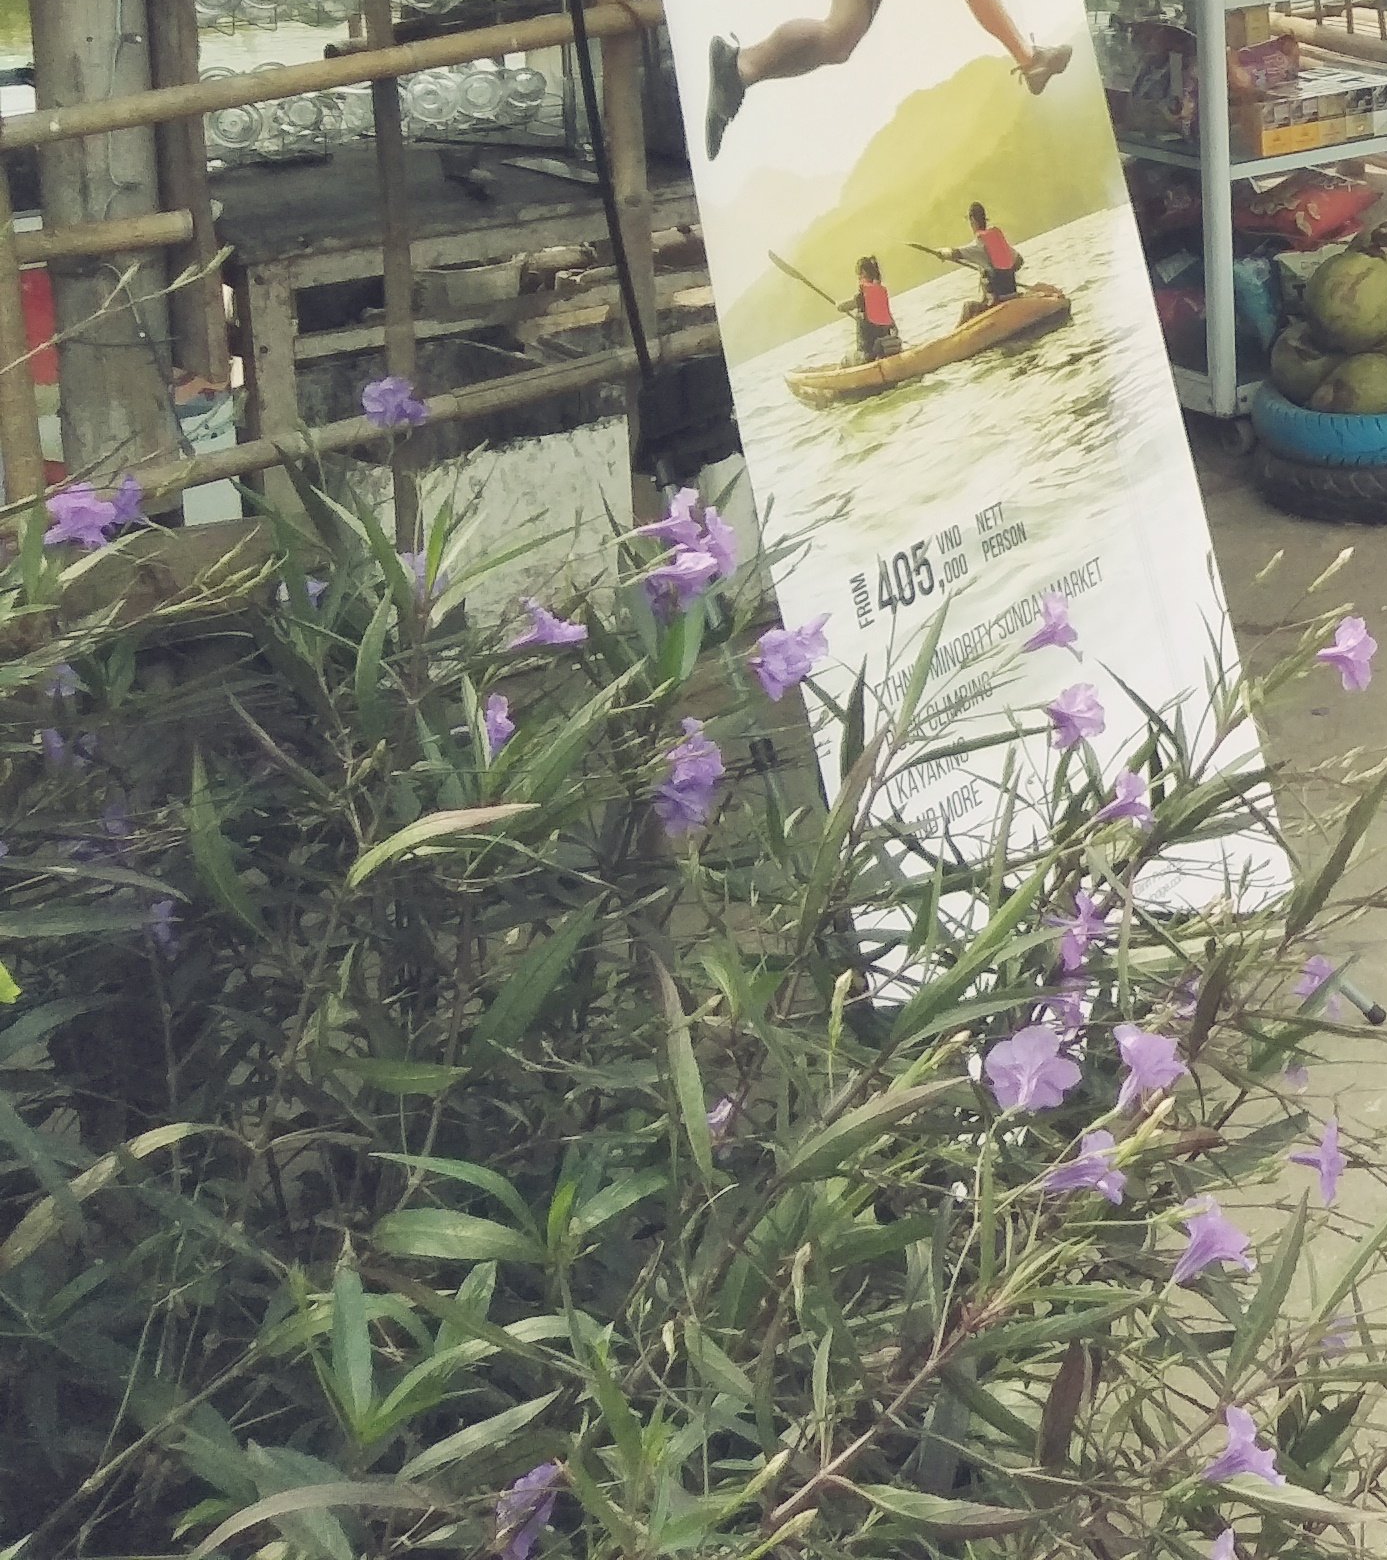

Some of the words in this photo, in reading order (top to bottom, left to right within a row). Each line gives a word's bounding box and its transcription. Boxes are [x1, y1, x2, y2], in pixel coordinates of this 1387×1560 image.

[936, 524, 963, 555] VND
[975, 501, 1005, 535] NETT
[981, 521, 1028, 563] PERSON
[850, 572, 875, 630] FROM
[938, 778, 984, 825] MORE
